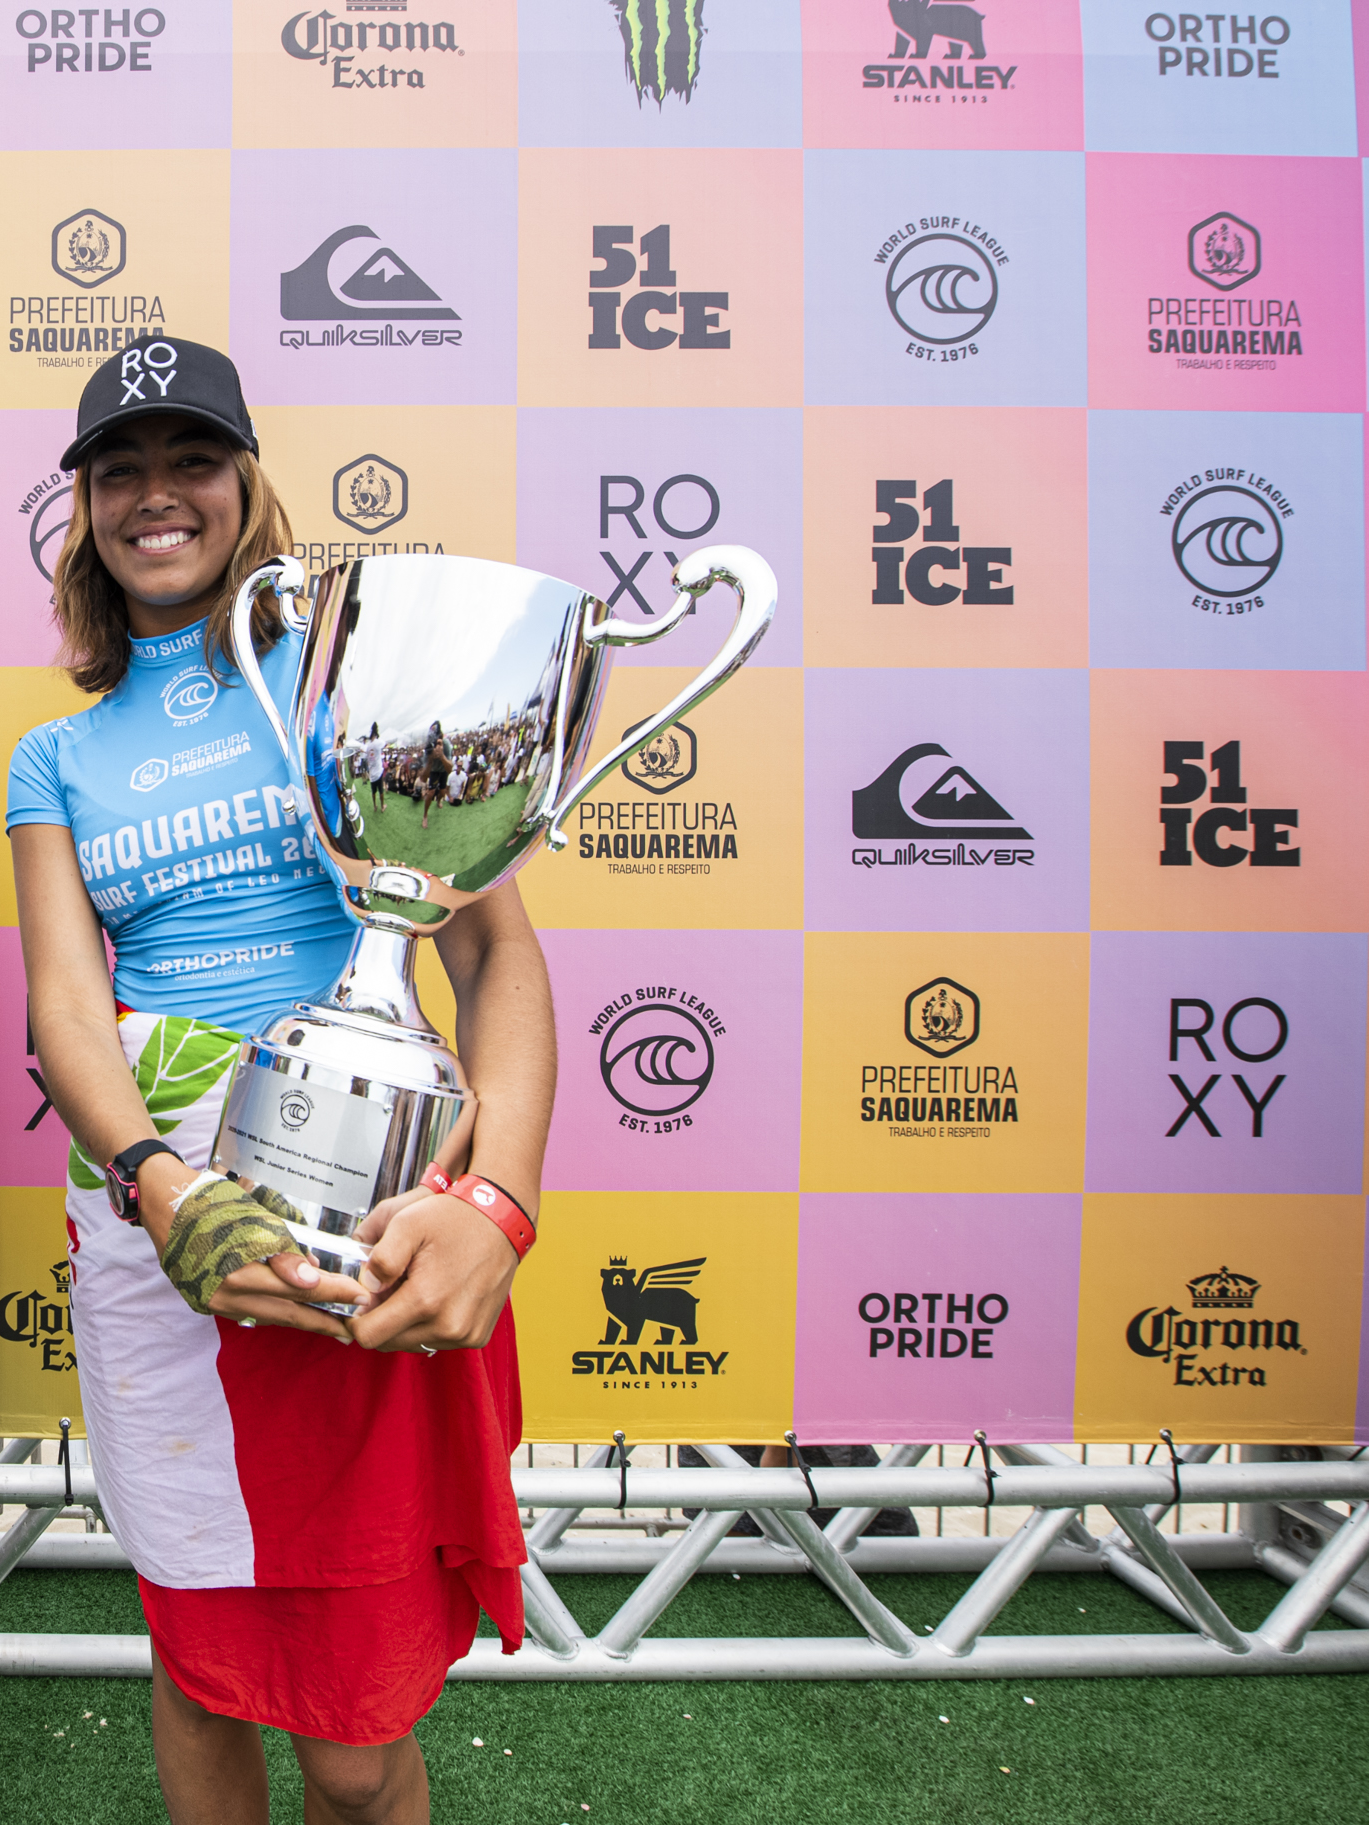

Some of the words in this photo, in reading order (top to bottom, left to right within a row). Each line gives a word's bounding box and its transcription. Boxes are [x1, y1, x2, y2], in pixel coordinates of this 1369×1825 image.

[15, 8, 166, 40] ORTHO
[281, 9, 460, 66] Corona
[1144, 12, 1291, 46] ORTHO
[27, 41, 153, 73] PRIDE
[331, 55, 426, 90] Extra
[1158, 45, 1280, 79] PRIDE
[862, 65, 1018, 90] STANLEY
[893, 94, 941, 104] SINCE
[951, 94, 988, 104] 1913
[589, 224, 677, 289] 51
[873, 223, 917, 267] WORLD
[919, 216, 961, 233] SURF
[962, 220, 1010, 268] LEAGUE
[9, 295, 167, 325] PREFEITURA
[588, 290, 731, 350] ICE
[1148, 298, 1303, 328] PREFEITURA
[280, 323, 463, 350] QUIKSILVER
[905, 341, 937, 363] EST.
[940, 342, 980, 363] 1976
[1148, 328, 1304, 355] SAQUAREMA
[37, 357, 85, 368] TRABALHO
[87, 357, 93, 368] E
[121, 342, 178, 378] RO
[119, 369, 177, 406] XY
[18, 475, 62, 516] WORLD
[600, 474, 720, 540] RO
[1159, 474, 1202, 516] WORLD
[1204, 468, 1246, 483] SURF
[1247, 473, 1294, 519] LEAGUE
[873, 479, 960, 543] 51
[872, 545, 1014, 606] ICE
[1191, 595, 1223, 616] EST.
[1226, 596, 1266, 616] 1976
[160, 629, 204, 657] SURF
[171, 741, 252, 777] SAQUAREMA
[172, 731, 250, 765] PREFEITURA
[1161, 740, 1247, 804] 51
[79, 783, 299, 882] SAQUAREM
[578, 802, 738, 831] PREFEITURA
[578, 833, 739, 861] SAQUAREMA
[1159, 807, 1301, 867] ICE
[607, 864, 655, 875] TRABALHO
[658, 864, 664, 874] E
[667, 864, 711, 875] RESPEITO
[852, 842, 1036, 869] QUIKSILVER
[91, 880, 138, 912] SURF
[141, 842, 272, 897] FESTIVAL
[174, 970, 216, 982] ortodontia
[588, 993, 632, 1037] WORLD
[635, 986, 677, 1001] SURF
[678, 991, 727, 1039] LEAGUE
[1169, 997, 1289, 1063] RO
[860, 1066, 1018, 1094] PREFEITURA
[860, 1096, 1019, 1123] SAQUAREMA
[1165, 1074, 1286, 1138] XY
[618, 1114, 651, 1134] EST.
[654, 1114, 694, 1134] 1976
[889, 1127, 937, 1138] TRABALHO
[939, 1127, 945, 1138] E
[947, 1127, 991, 1138] RESPEITO
[303, 1153, 333, 1168] Regional
[333, 1163, 369, 1179] Champion
[858, 1292, 1010, 1325] ORTHO
[869, 1327, 995, 1360] PRIDE
[1126, 1305, 1305, 1364] Corona
[571, 1351, 730, 1375] STANLEY
[1173, 1353, 1268, 1388] Extra
[602, 1381, 651, 1390] SINCE
[660, 1381, 699, 1390] 1913
